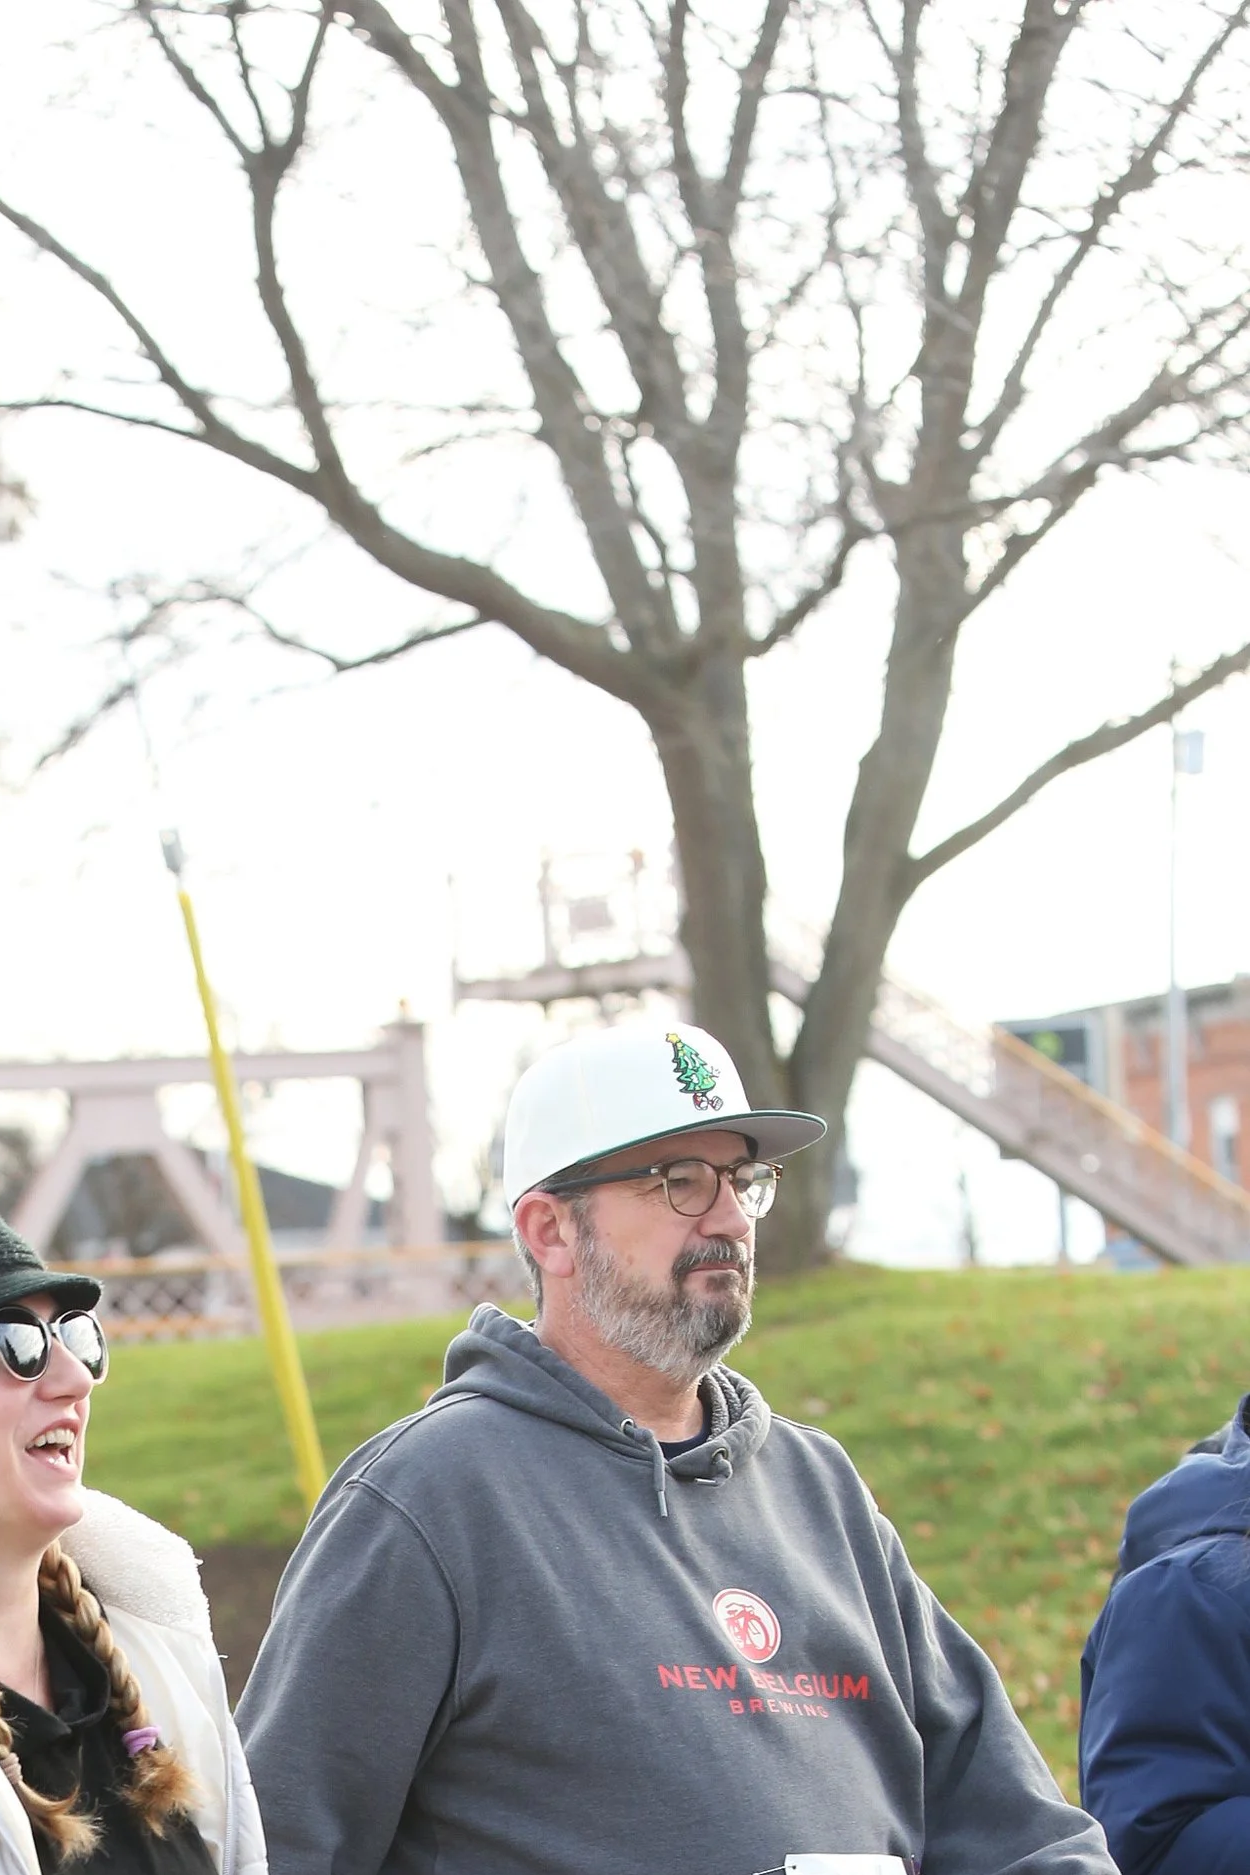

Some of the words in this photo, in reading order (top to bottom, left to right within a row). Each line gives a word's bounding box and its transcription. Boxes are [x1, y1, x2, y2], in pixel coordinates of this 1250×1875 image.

[657, 1664, 738, 1691] NEW
[747, 1667, 870, 1700] BELGIUM
[729, 1698, 829, 1719] BREWING
